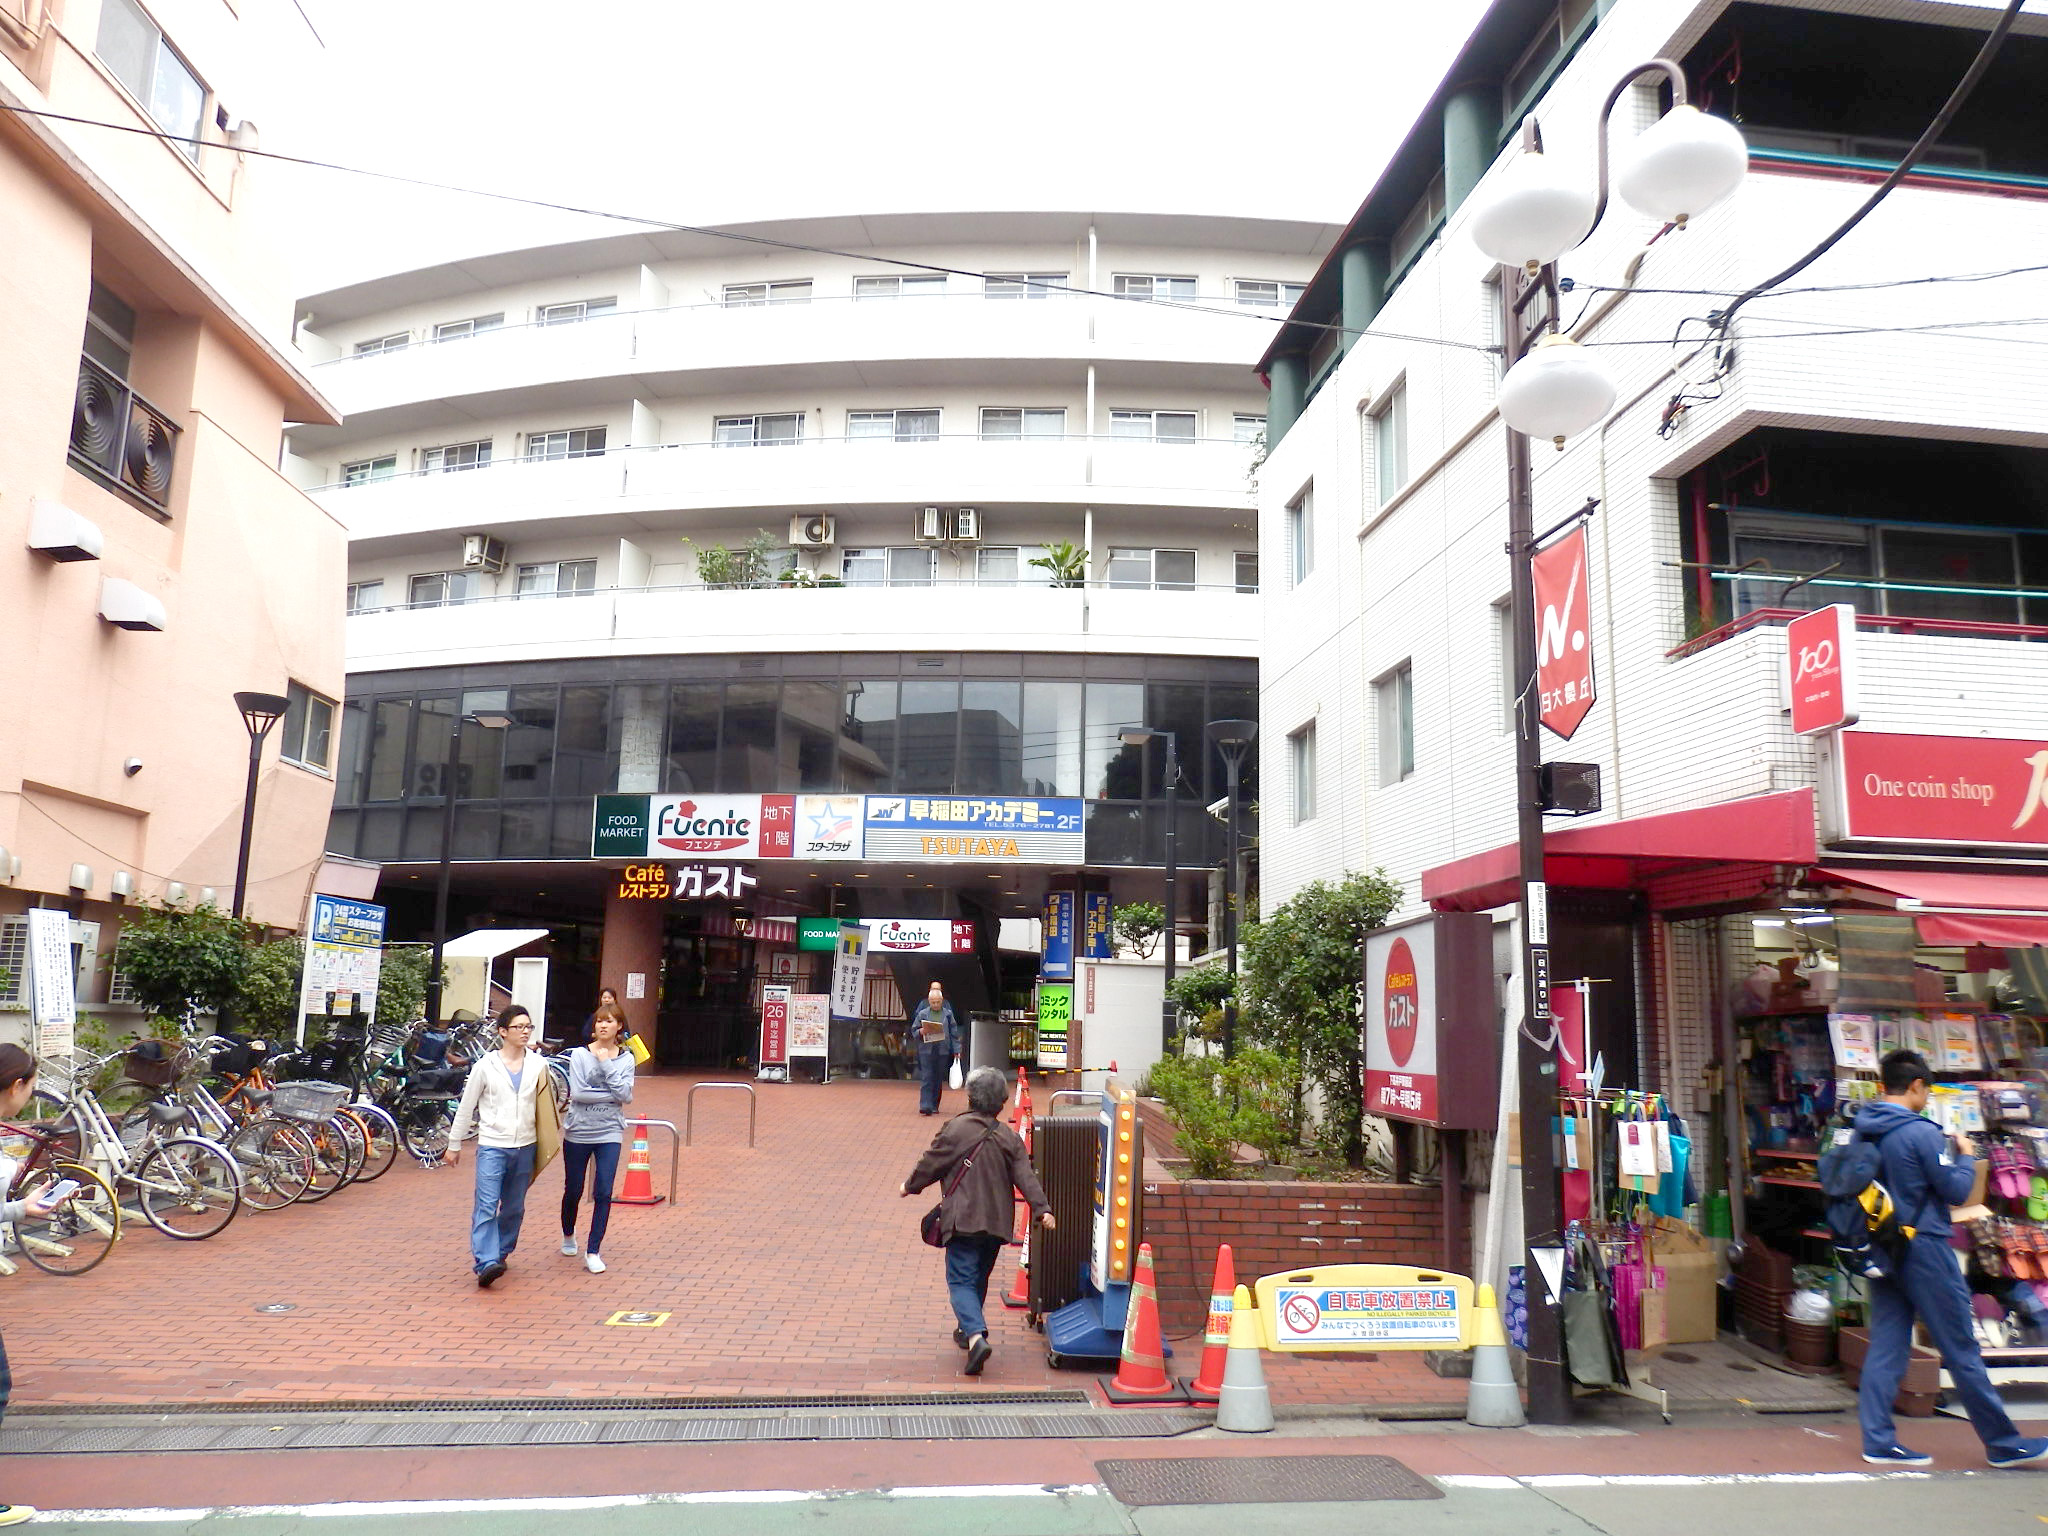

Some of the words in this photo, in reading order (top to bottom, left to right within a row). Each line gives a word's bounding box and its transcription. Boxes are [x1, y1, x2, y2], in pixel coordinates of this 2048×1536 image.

[1795, 640, 1833, 684] 100
[1864, 773, 1904, 796] One
[1907, 775, 1947, 798] coin
[1951, 776, 1994, 806] shop
[763, 806, 792, 820] 地下
[909, 800, 1055, 822] 早稲田アカデミー
[608, 815, 637, 825] FOOD
[658, 804, 750, 836] Fuente
[1057, 815, 1080, 829] 2F
[600, 828, 644, 838] MARKET
[763, 831, 790, 845] 1階
[684, 840, 722, 849] フエンテ
[806, 841, 851, 852] スタープラザ
[921, 837, 1020, 856] TSUTAYA
[625, 864, 664, 882] Café
[675, 865, 758, 897] ガスト
[619, 884, 669, 898] レストラン
[348, 906, 384, 920] スタープラザ
[803, 930, 824, 938] FOOD
[880, 924, 931, 941] Fuente
[952, 924, 972, 934] 地下
[1087, 910, 1097, 956] アカデミー
[953, 938, 971, 949] 1階
[1040, 995, 1069, 1006] コミック
[767, 1005, 784, 1018] 26
[1039, 1009, 1069, 1019] レンタル
[1389, 994, 1414, 1028] ガスト
[1329, 1292, 1450, 1309] 自転車放置禁止
[1321, 1320, 1456, 1330] みんなでつくろう放置自転車のないまち
